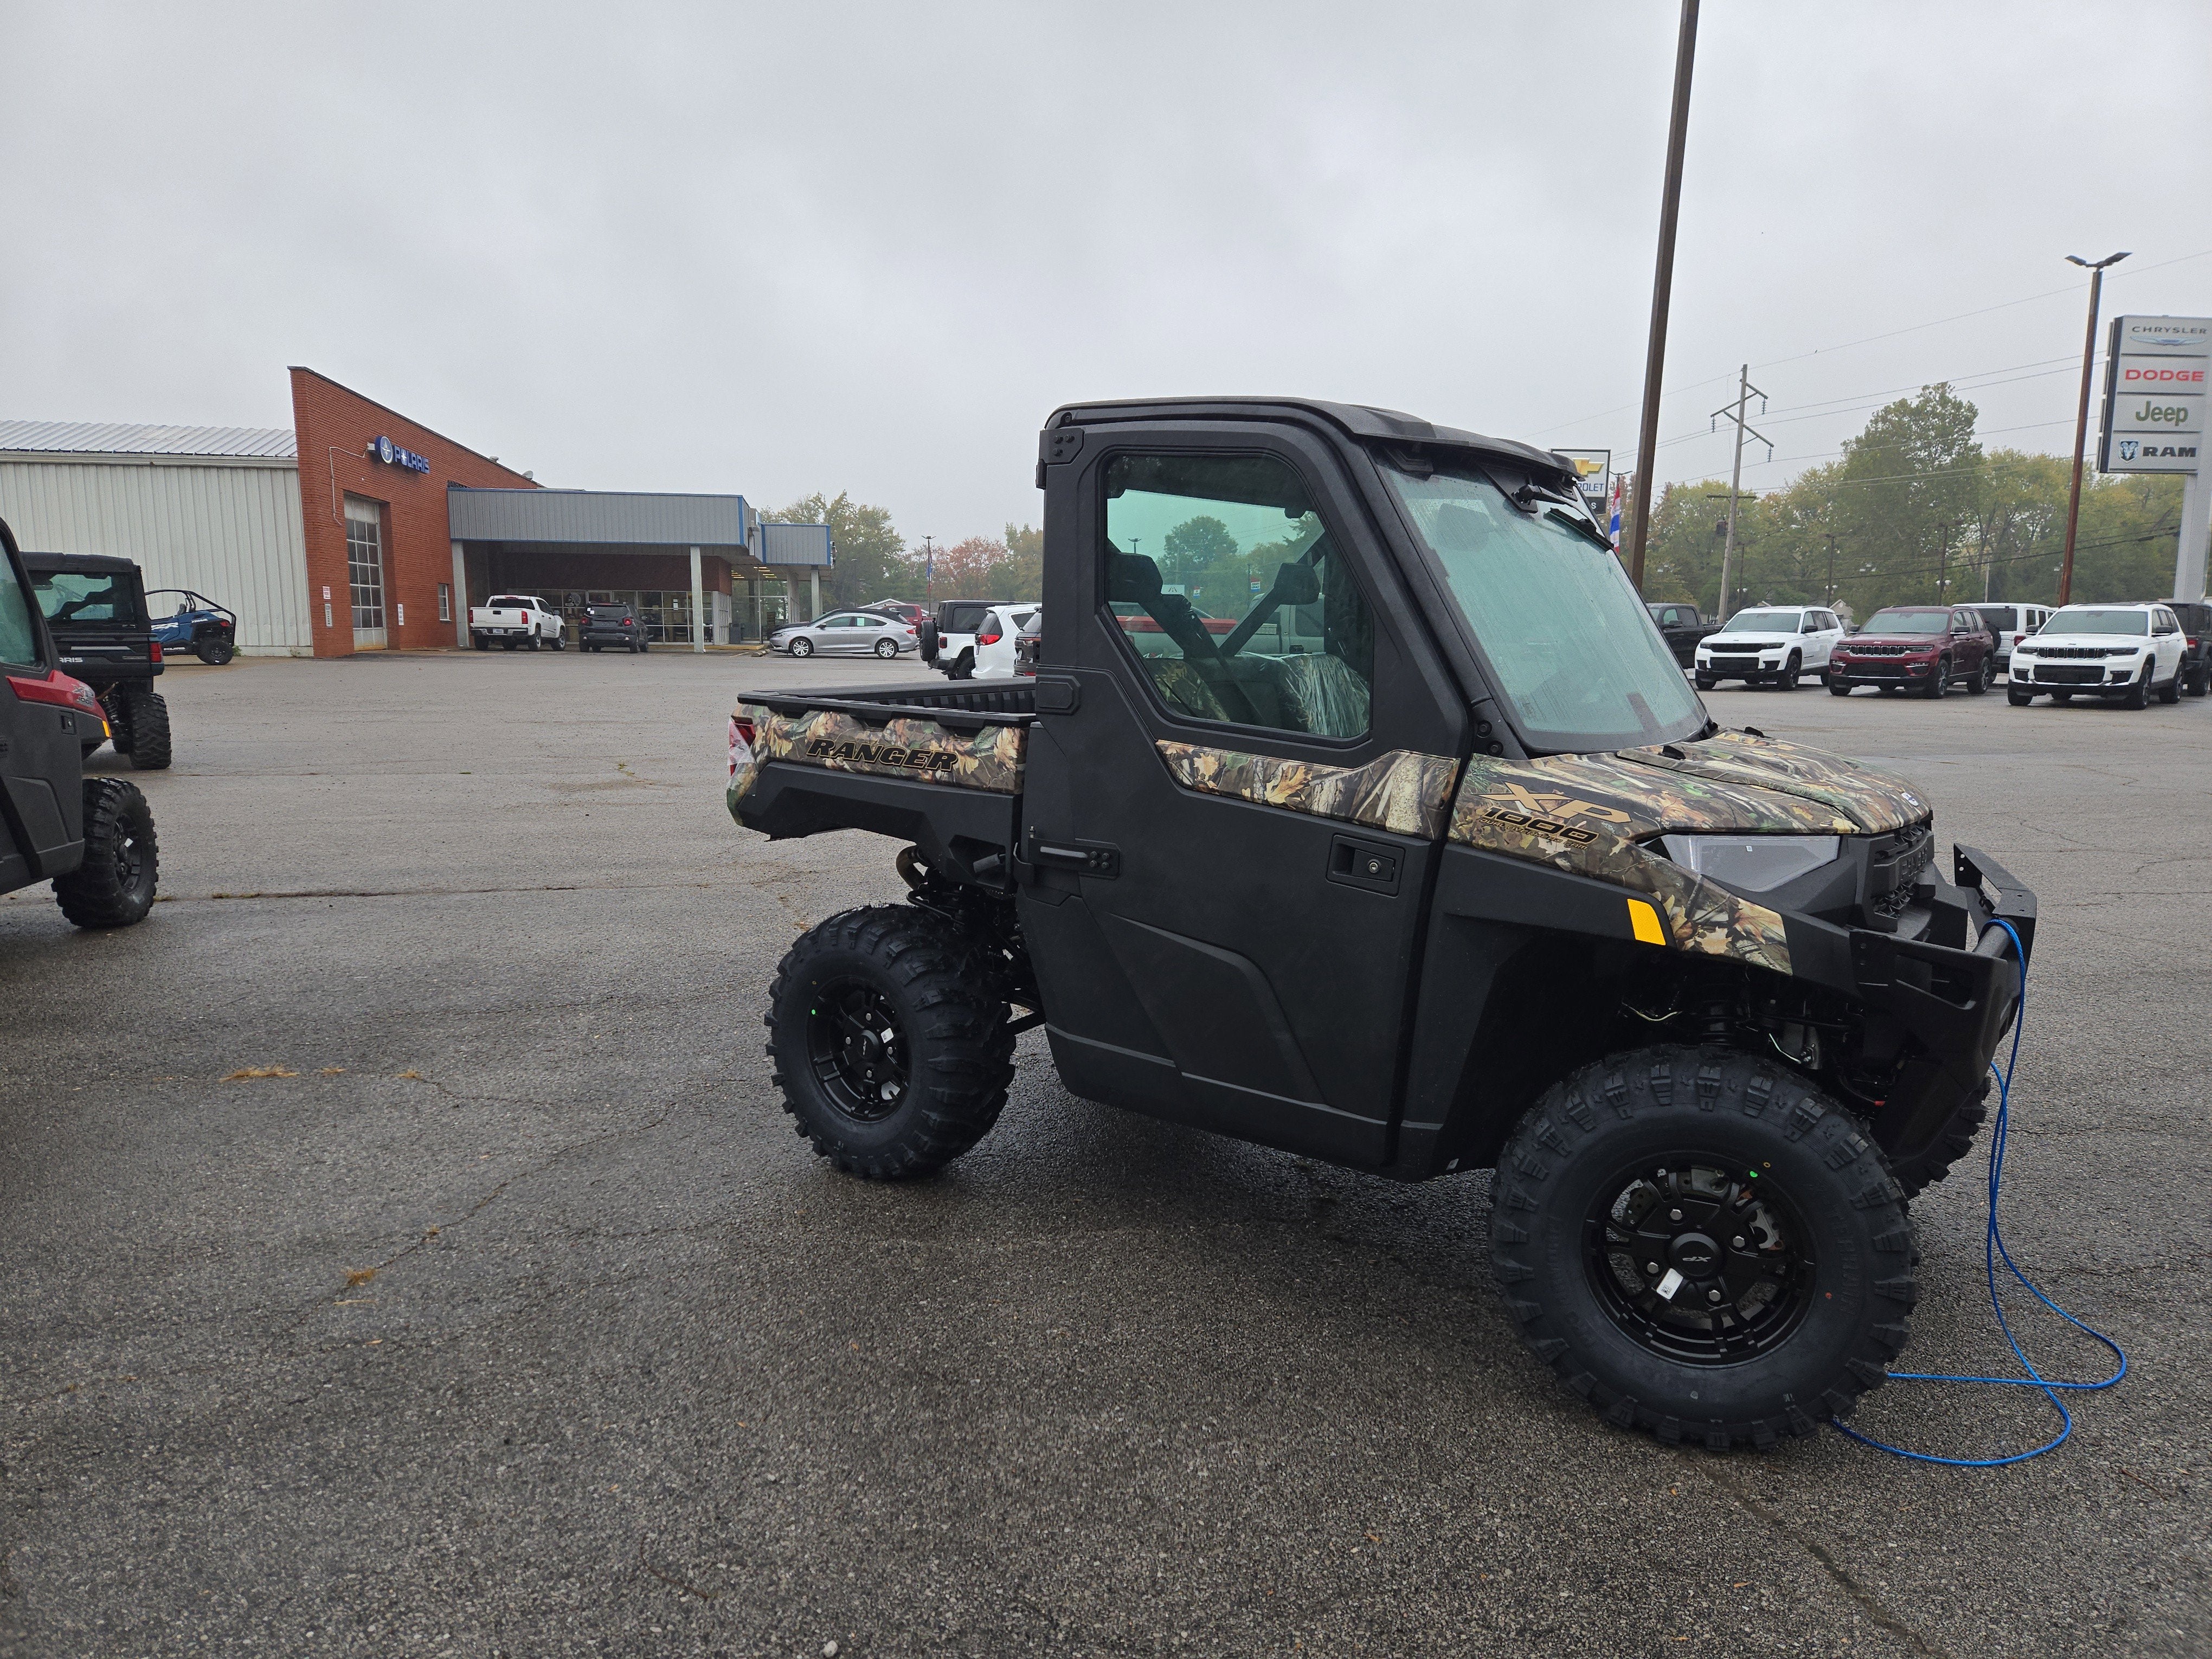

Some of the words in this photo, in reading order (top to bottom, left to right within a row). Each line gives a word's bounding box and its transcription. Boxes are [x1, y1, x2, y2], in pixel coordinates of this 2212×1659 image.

[2132, 325, 2208, 335] CHRYSLER
[2125, 369, 2205, 382] DODGE
[2135, 400, 2189, 427] Jeep
[394, 445, 430, 474] POLARIS
[2142, 446, 2197, 458] RAM
[806, 738, 959, 771] RANGER
[1477, 781, 1632, 824] XP
[1479, 818, 1506, 828] DUAL
[1507, 825, 1564, 844] OVERHEAD
[1564, 840, 1589, 850] CAM
[1482, 806, 1600, 845] 1000
